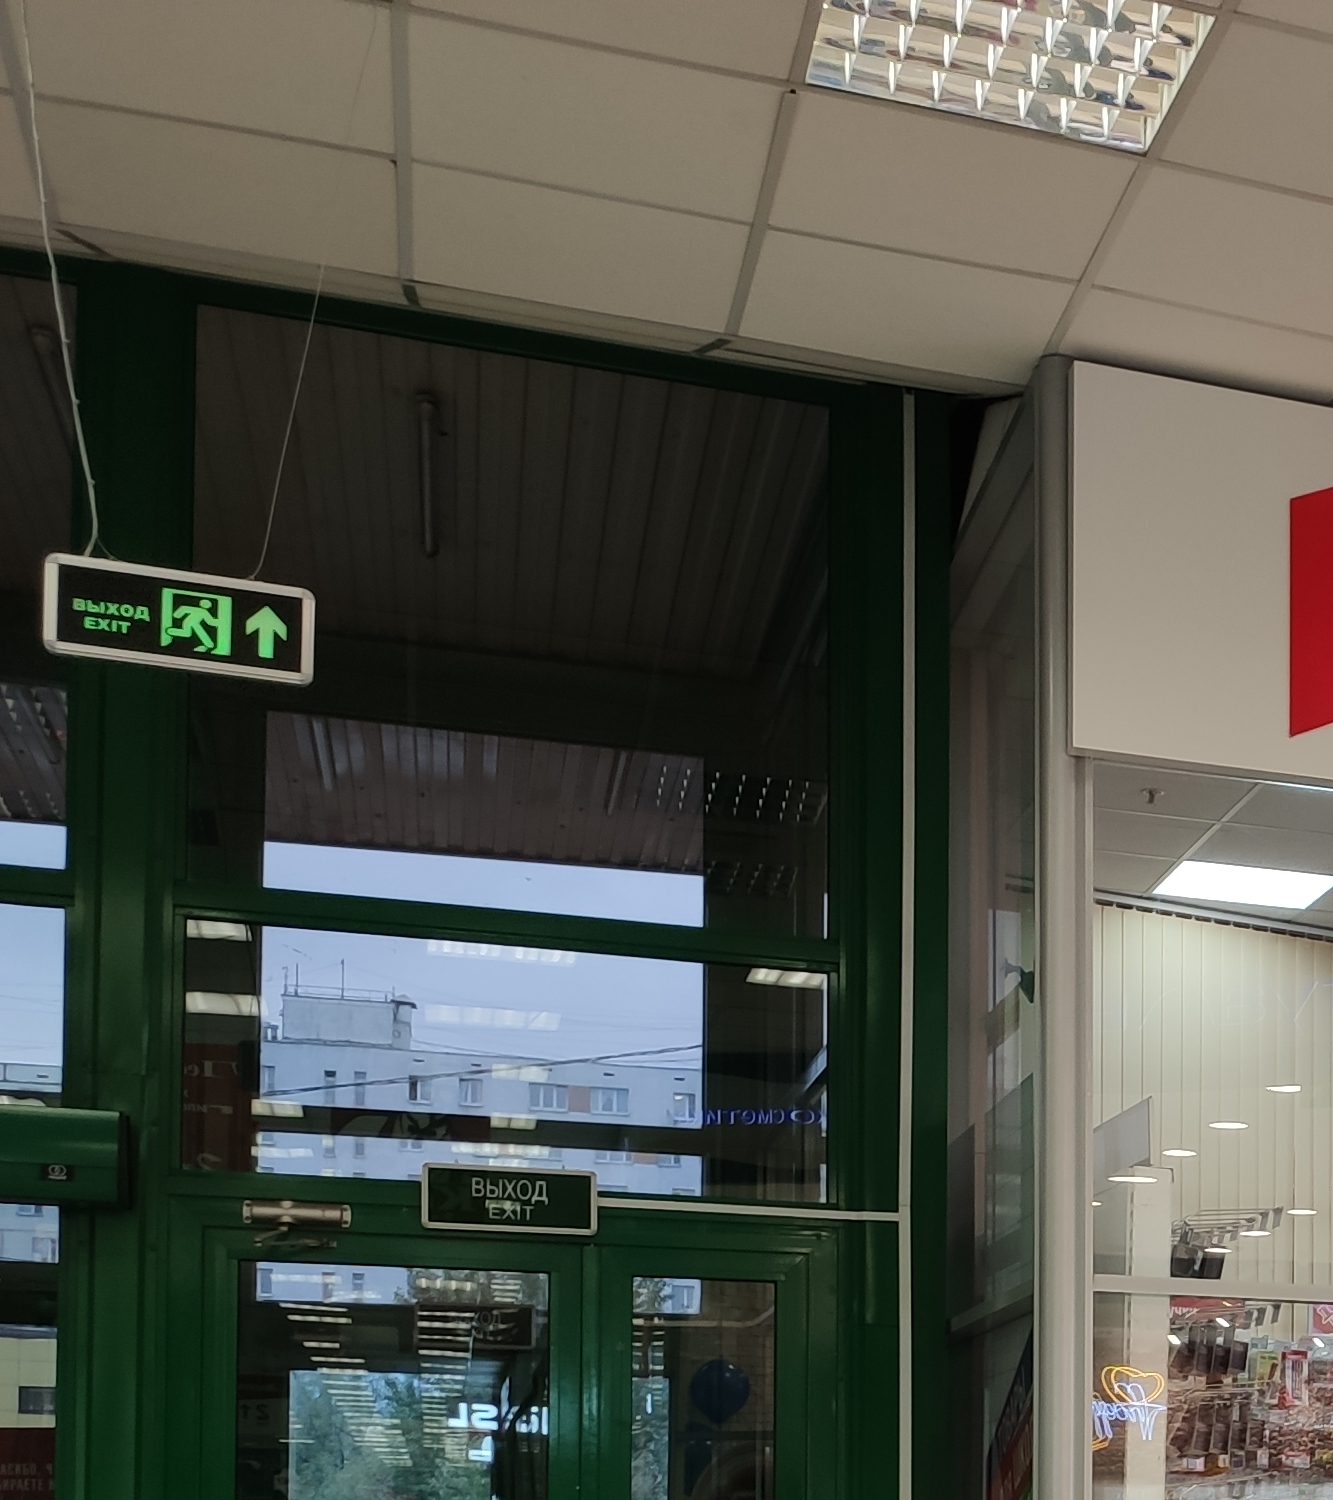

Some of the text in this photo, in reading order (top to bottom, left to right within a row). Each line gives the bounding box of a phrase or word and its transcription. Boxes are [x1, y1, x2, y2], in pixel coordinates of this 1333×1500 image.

[72, 598, 150, 622] ВЫХОД
[83, 616, 131, 634] EXIT
[471, 1177, 549, 1206] ВЫХОД
[488, 1205, 535, 1221] EXIT
